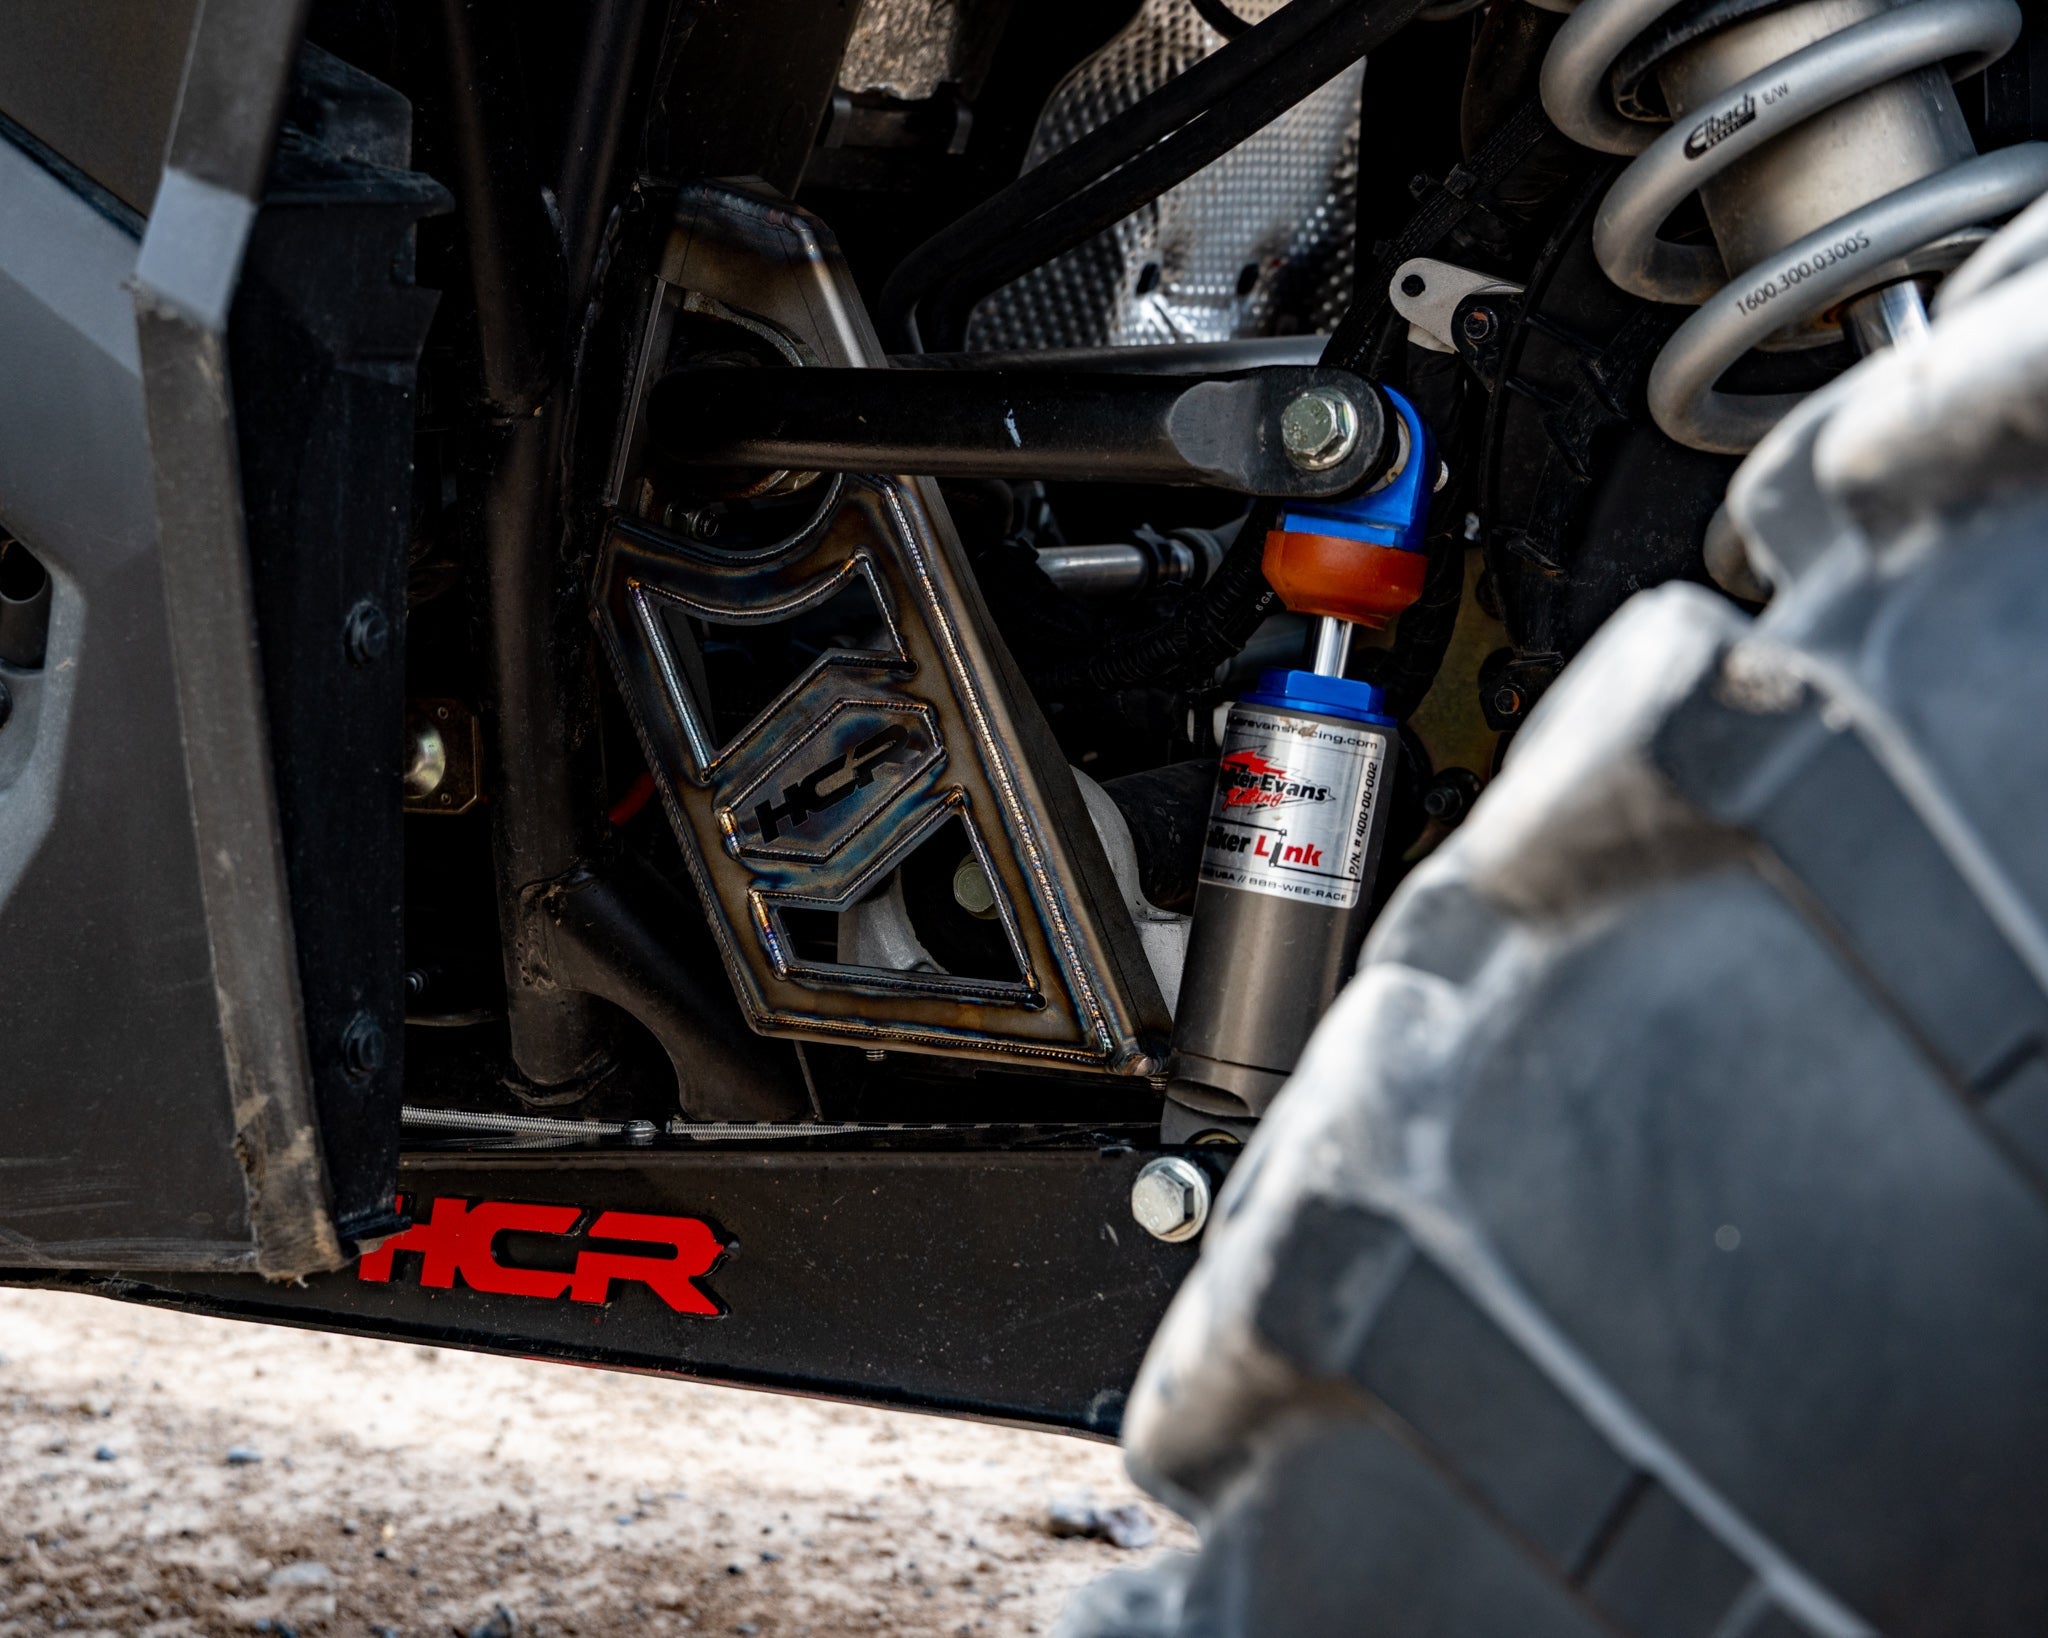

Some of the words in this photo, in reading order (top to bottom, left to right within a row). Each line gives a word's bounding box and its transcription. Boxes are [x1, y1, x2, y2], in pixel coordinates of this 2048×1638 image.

[754, 724, 921, 845] HCR
[1356, 761, 1378, 838] 400-00-002
[358, 1194, 726, 1316] HCR
